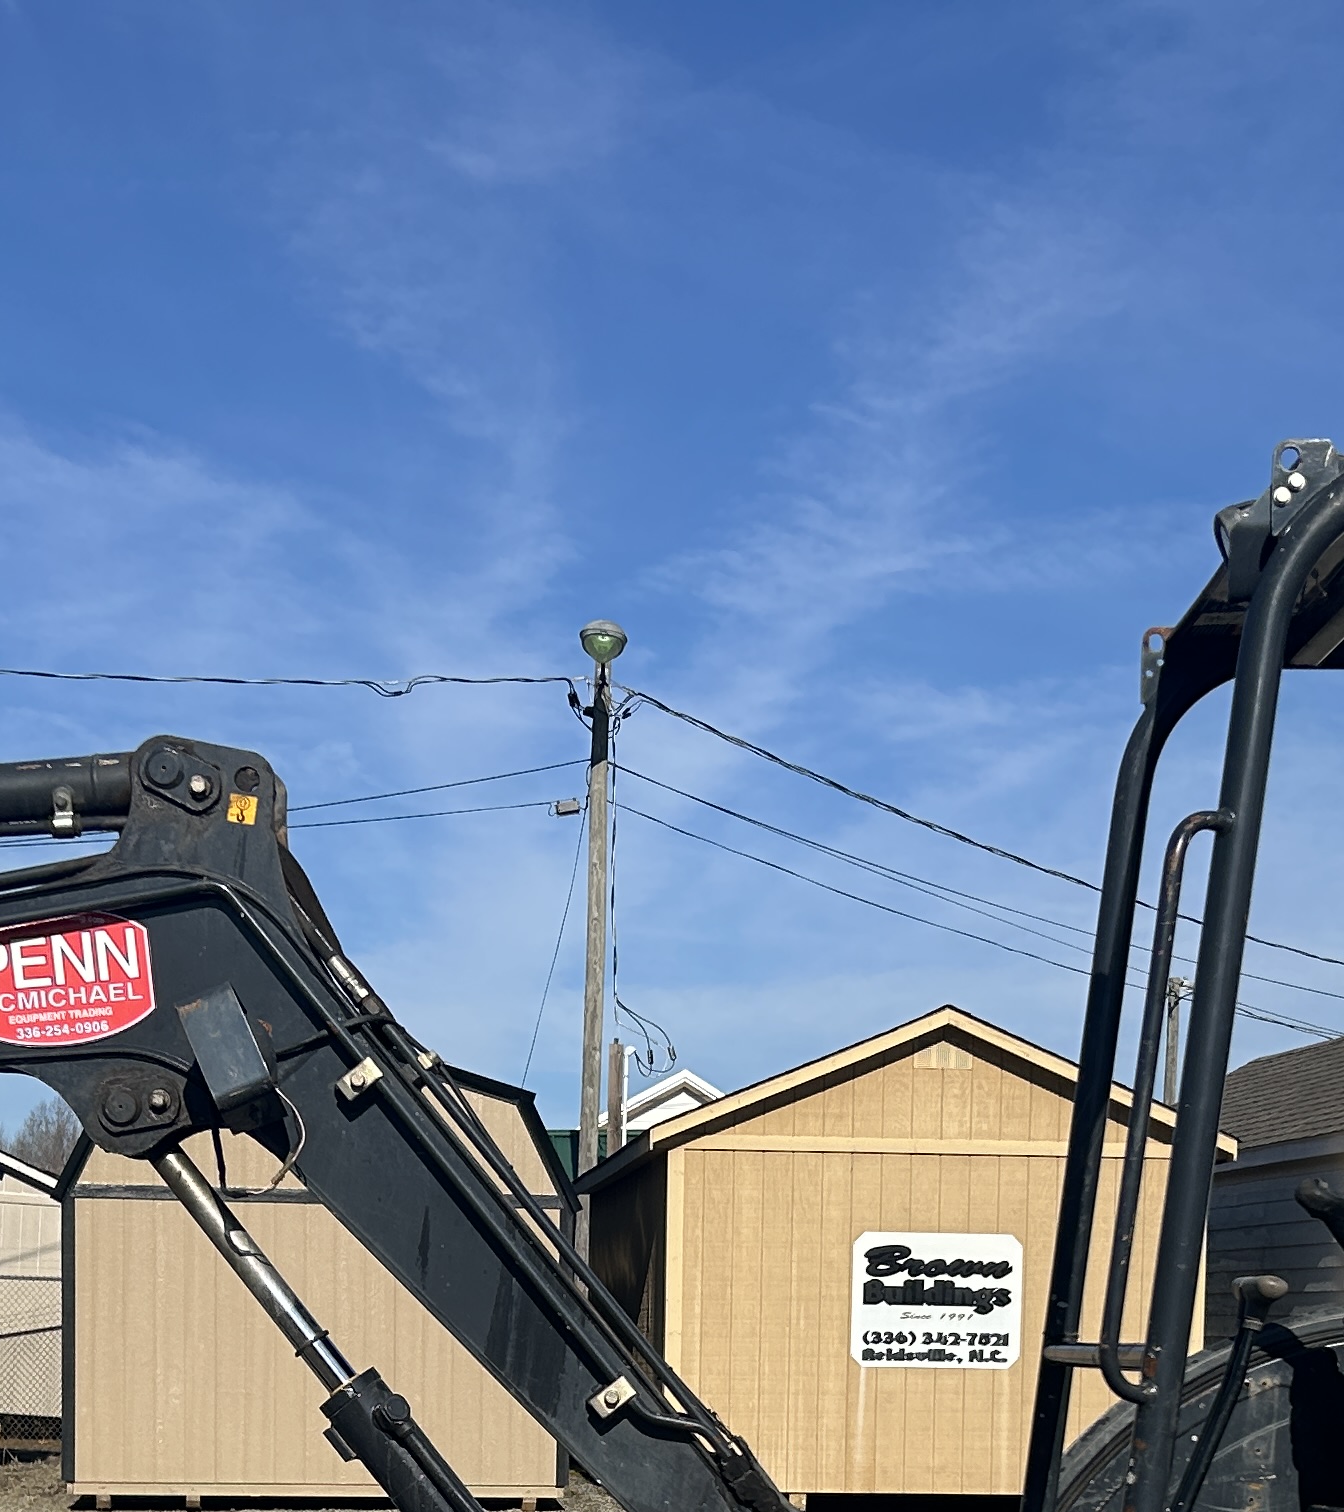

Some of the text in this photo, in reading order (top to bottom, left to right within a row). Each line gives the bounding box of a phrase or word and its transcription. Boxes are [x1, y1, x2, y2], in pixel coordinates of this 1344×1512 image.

[8, 1006, 114, 1025] EQUIPMENT TRADING
[16, 1020, 109, 1040] 336-254-0906
[863, 1244, 1013, 1279] Brown
[862, 1279, 1012, 1315] Buildings
[899, 1312, 932, 1320] Since
[862, 1331, 917, 1346] (336)
